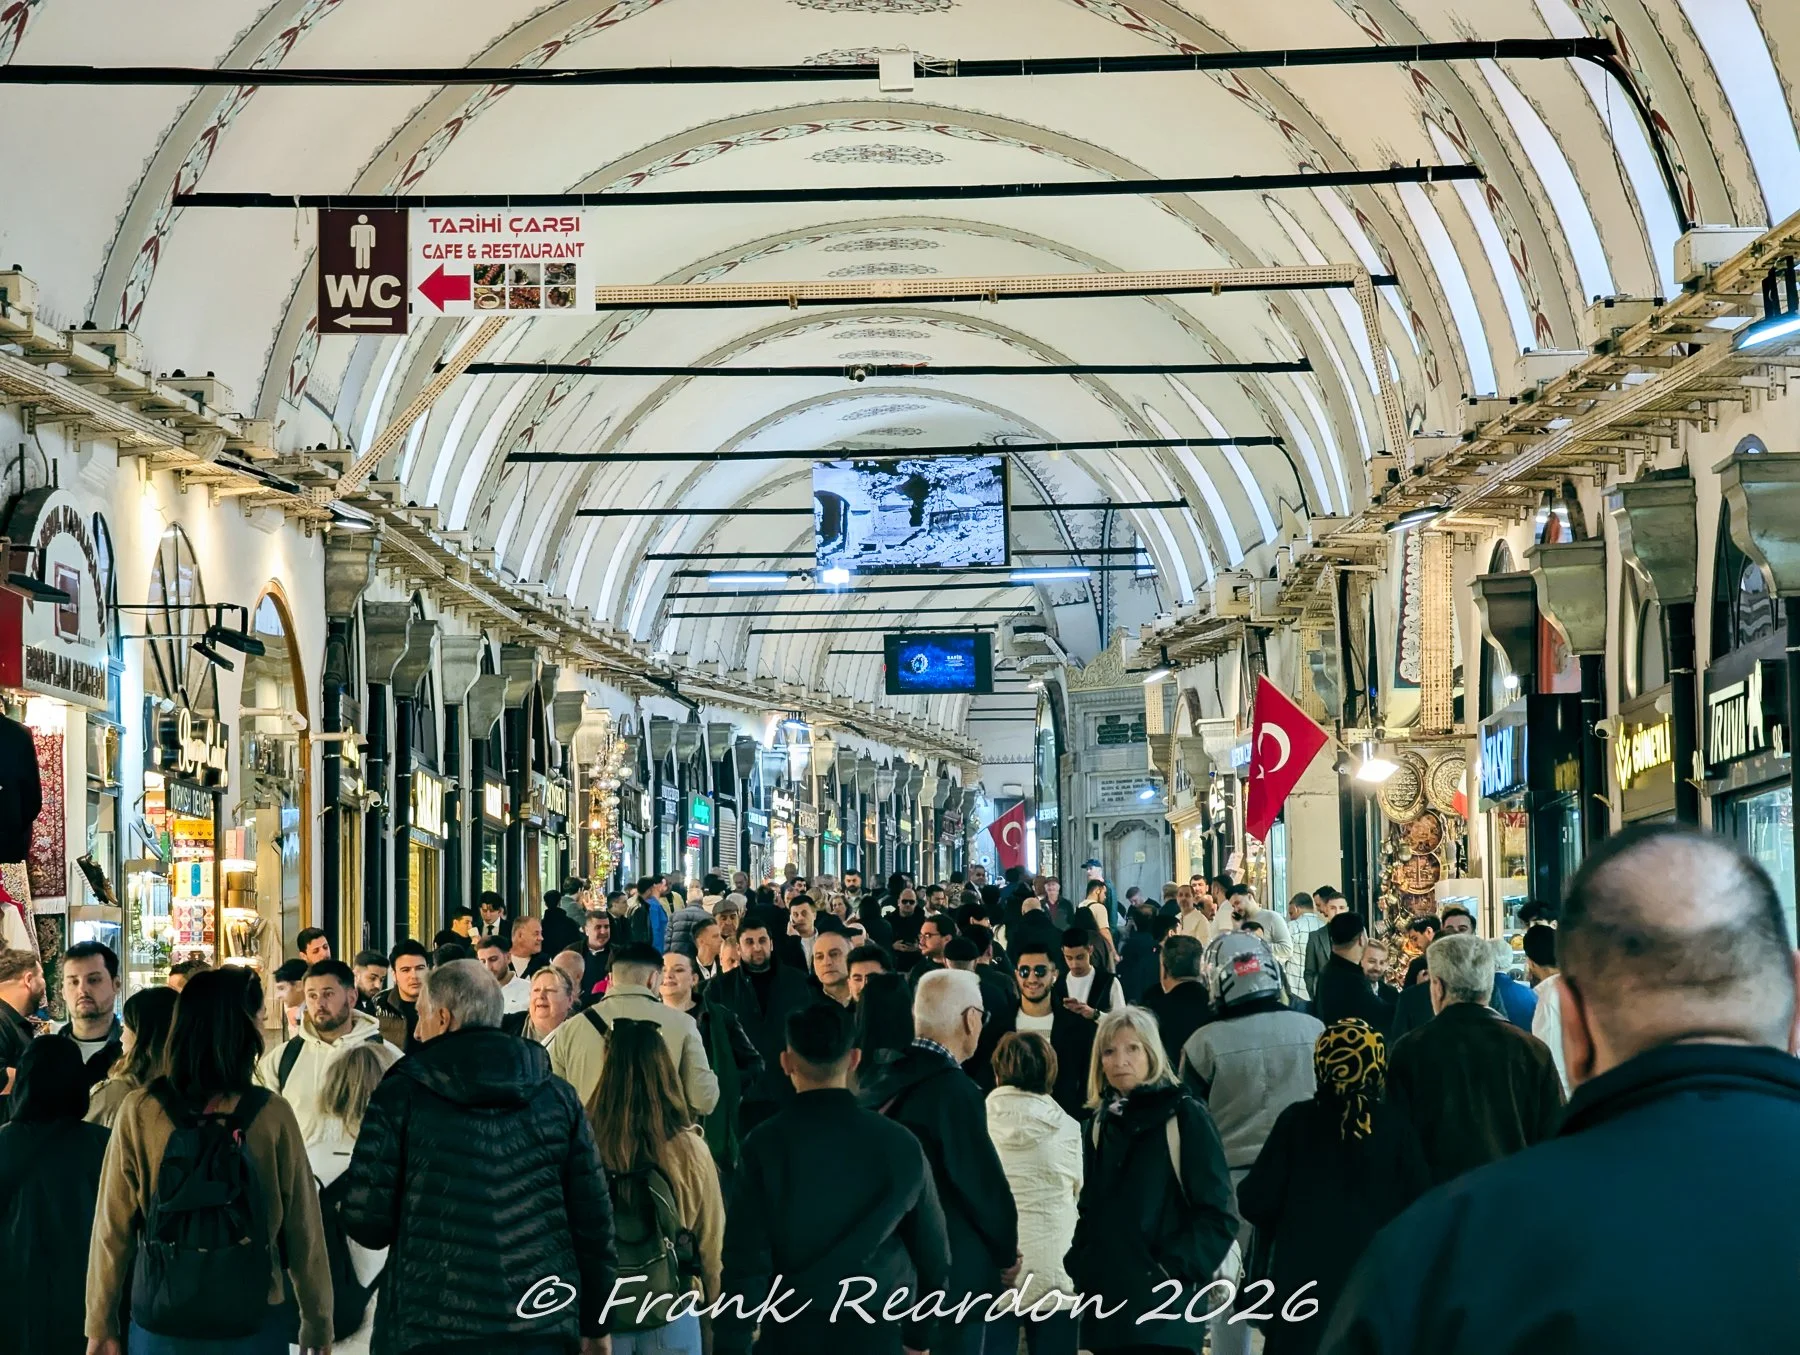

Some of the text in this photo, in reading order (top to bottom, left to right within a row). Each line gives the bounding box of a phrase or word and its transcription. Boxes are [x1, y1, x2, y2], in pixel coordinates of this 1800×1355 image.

[428, 213, 580, 238] TARİHİ ÇARŞI
[422, 242, 585, 259] CAFE & RESTAURANT
[324, 274, 401, 309] WC
[1708, 680, 1747, 765] TRUVA
[1632, 712, 1671, 774] GÜNEYLİ
[1772, 723, 1784, 759] 98
[1480, 725, 1513, 798] ATASAY
[169, 783, 213, 818] TURKISH DELIGHT
